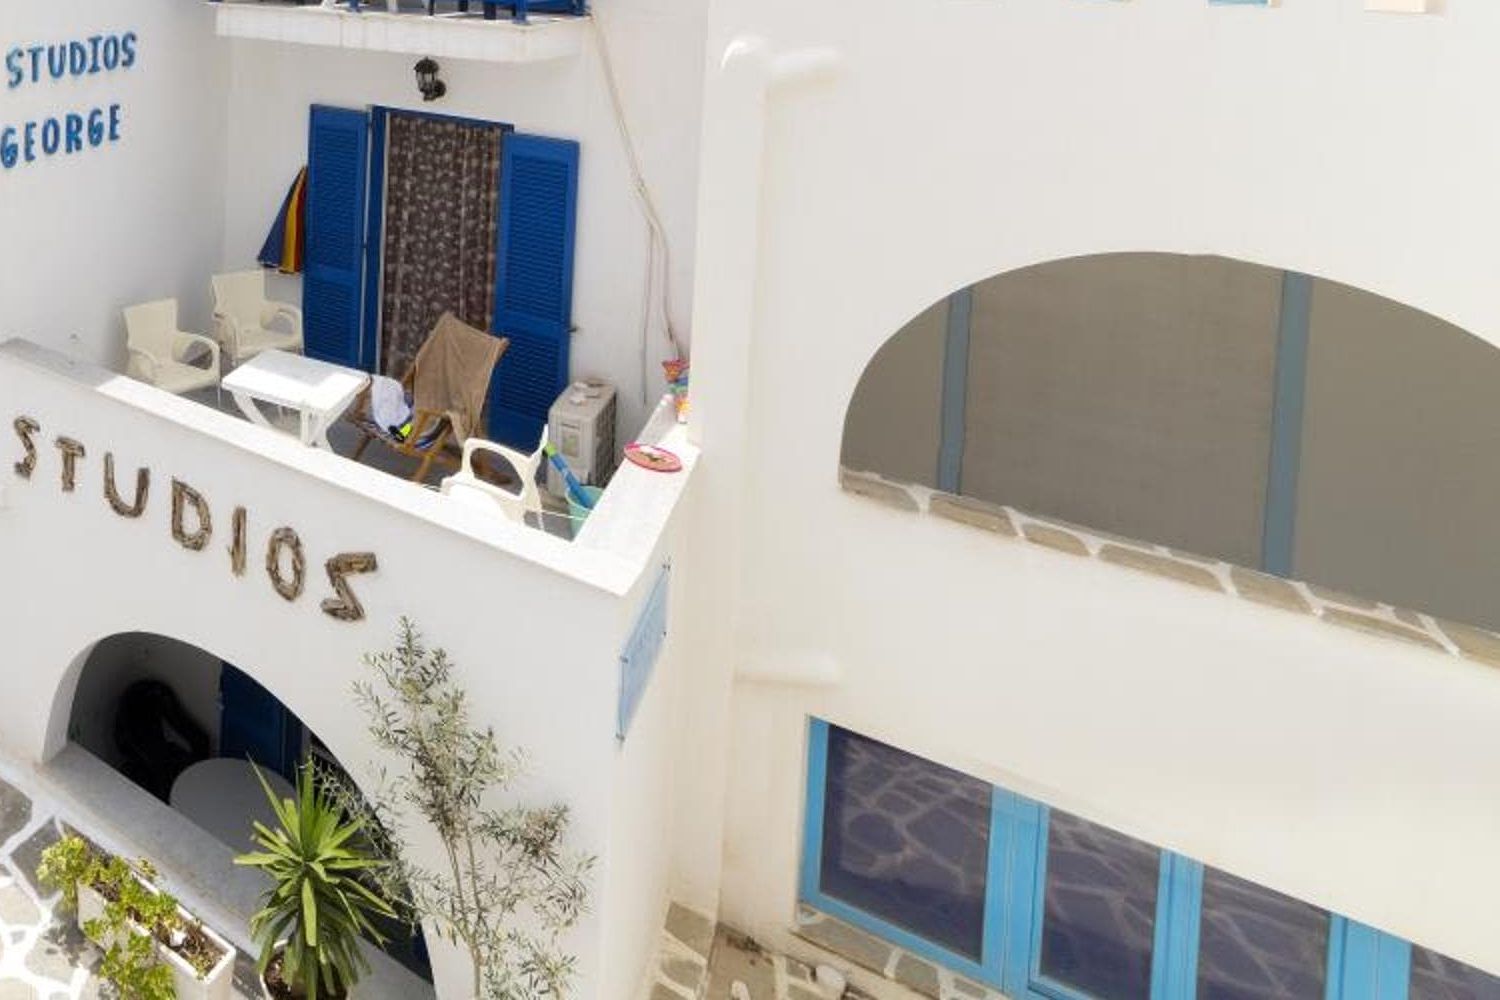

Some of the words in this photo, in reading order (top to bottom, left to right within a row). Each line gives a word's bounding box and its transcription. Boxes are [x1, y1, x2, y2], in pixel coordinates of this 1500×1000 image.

[5, 32, 137, 88] STUDIOS
[0, 104, 121, 169] GEORGE
[13, 416, 380, 622] STUDIOS
